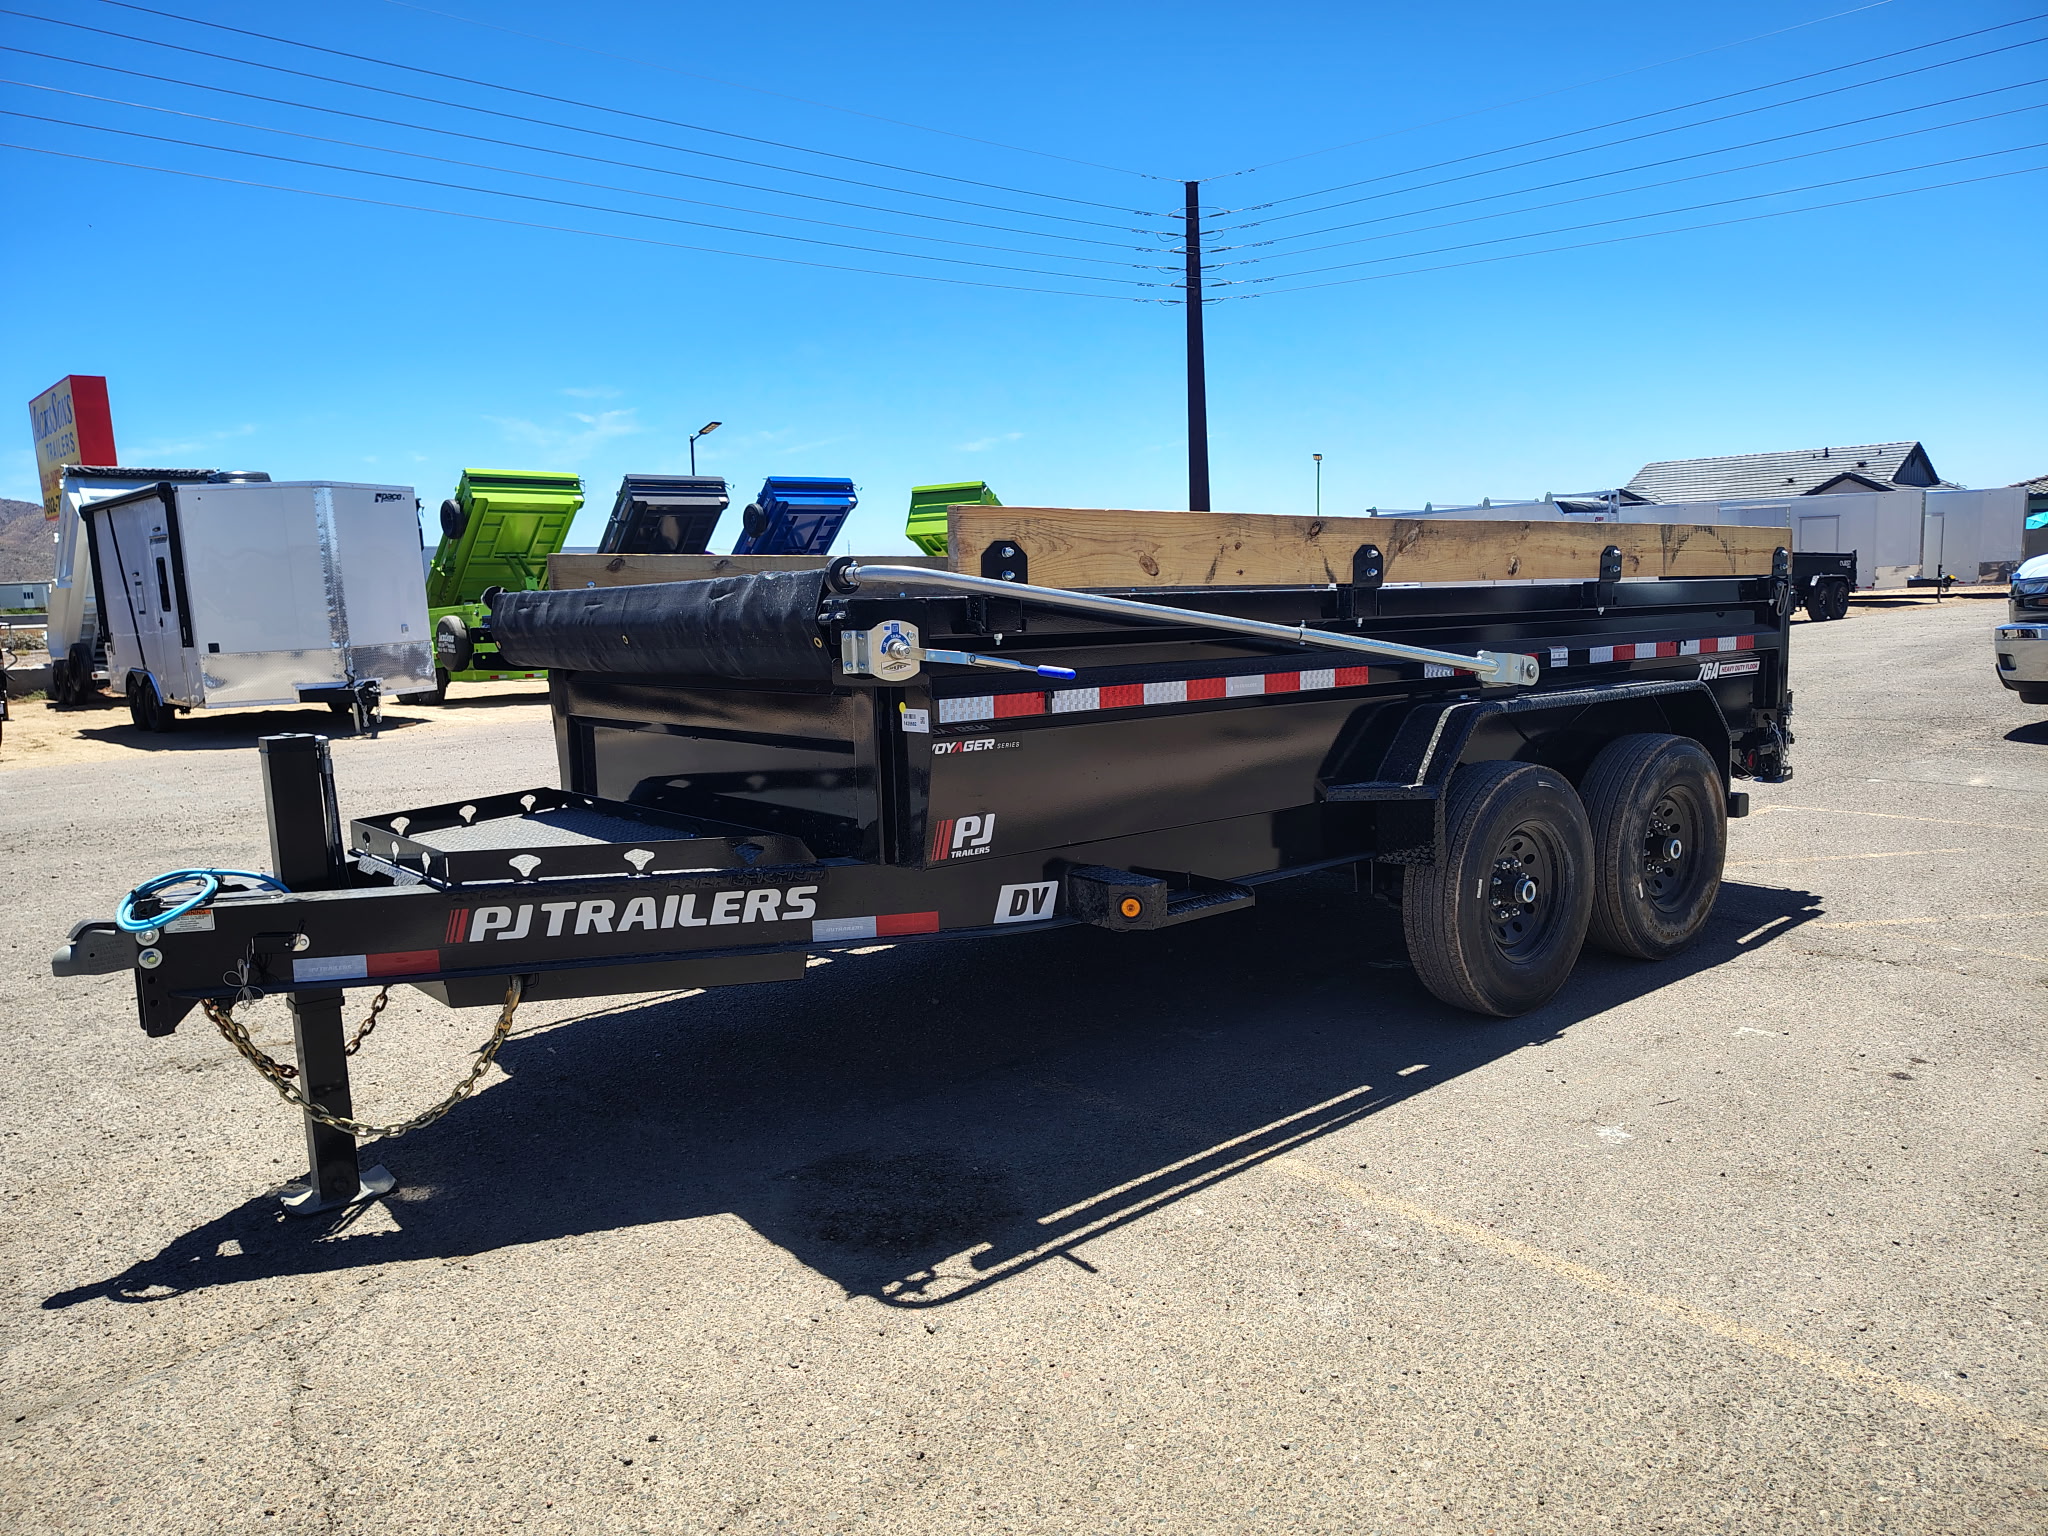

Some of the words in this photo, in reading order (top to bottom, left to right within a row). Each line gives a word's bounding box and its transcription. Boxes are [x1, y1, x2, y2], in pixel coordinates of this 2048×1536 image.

[46, 432, 75, 462] TRAILERS
[1697, 662, 1719, 681] 7GA
[1721, 665, 1735, 673] HEAVY
[996, 741, 1020, 749] SERIES
[952, 813, 996, 849] PJ
[951, 846, 990, 859] TRAILERS
[1008, 886, 1050, 917] DV
[468, 904, 534, 943] PJ
[540, 885, 818, 937] TRAILERS
